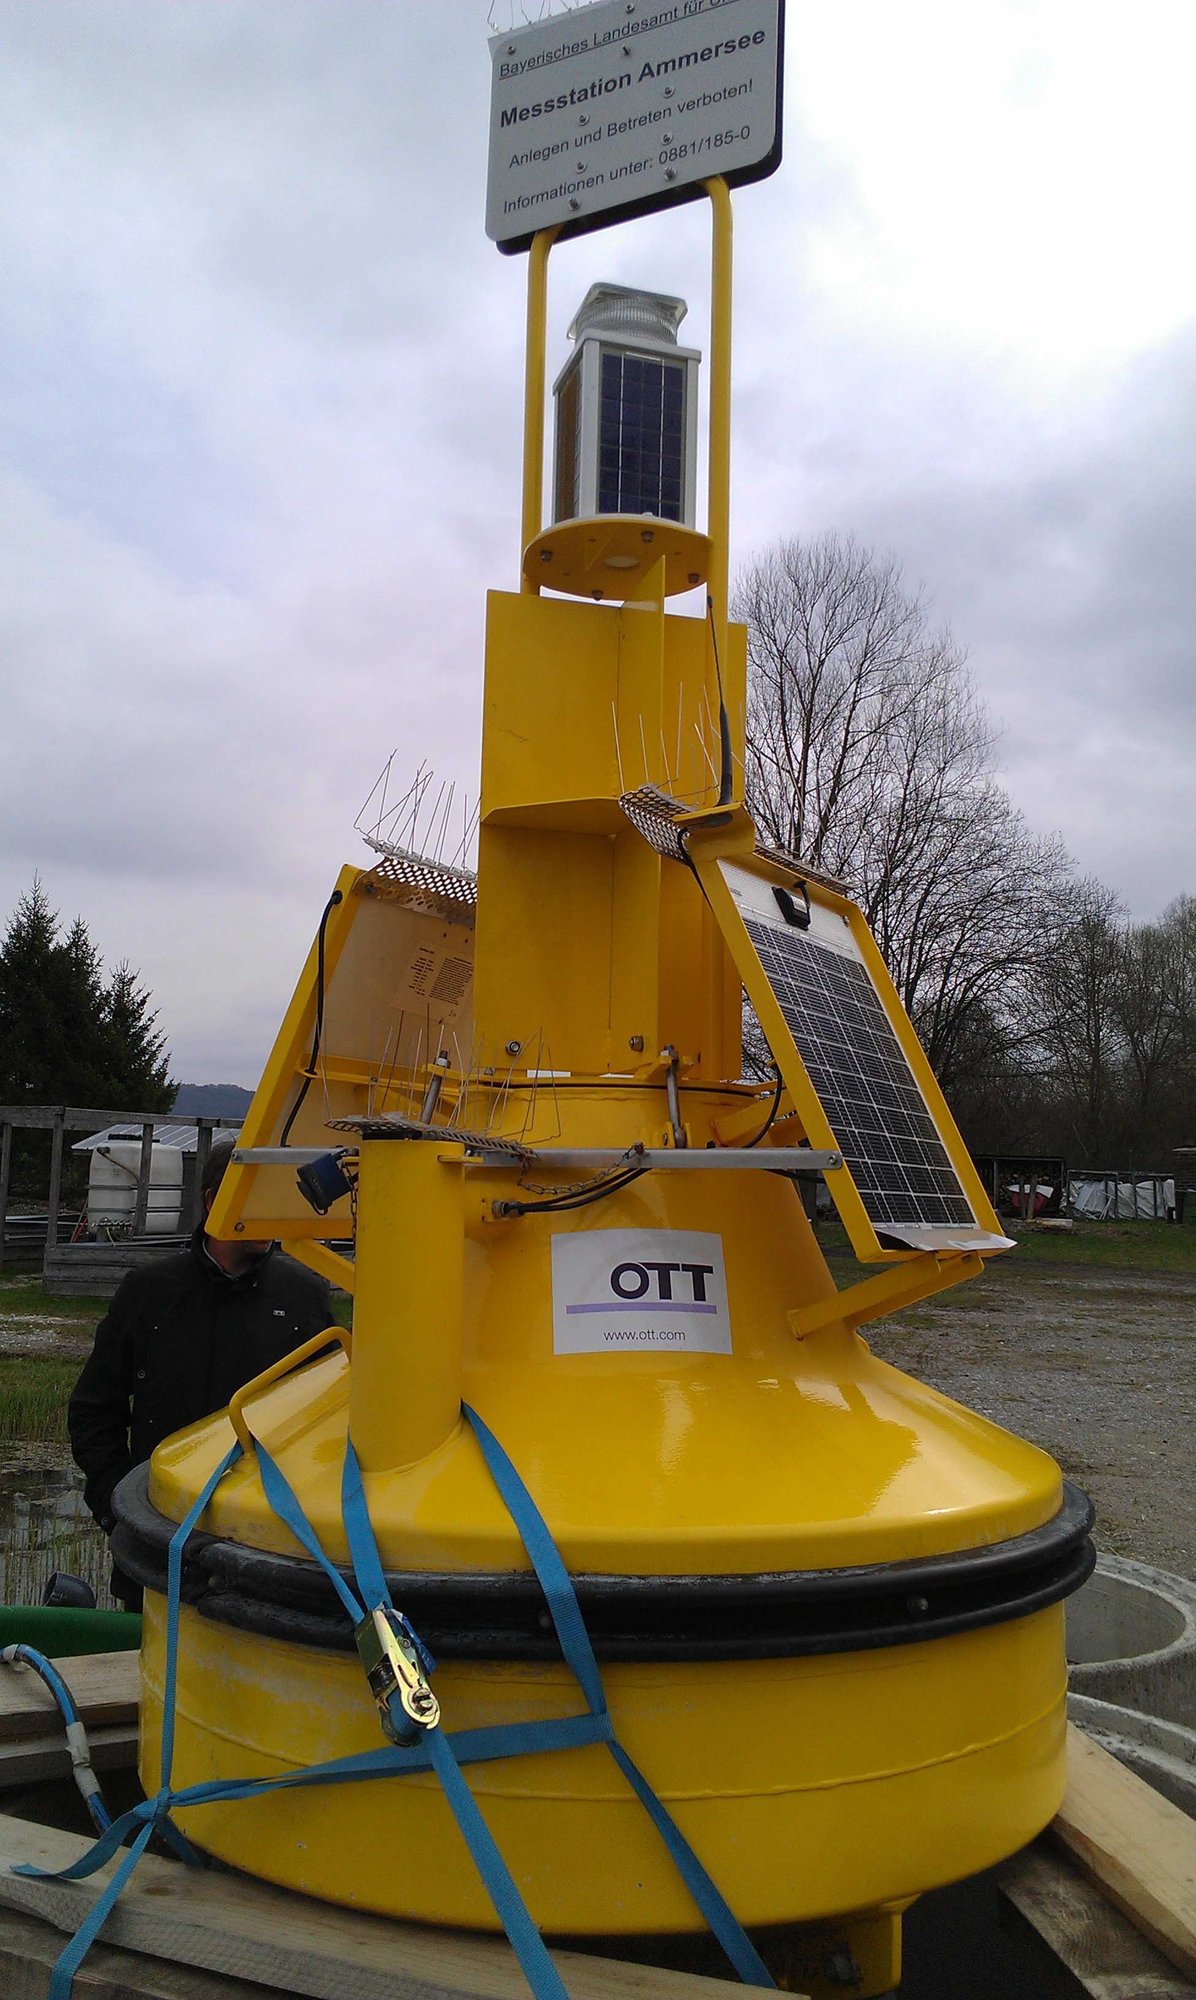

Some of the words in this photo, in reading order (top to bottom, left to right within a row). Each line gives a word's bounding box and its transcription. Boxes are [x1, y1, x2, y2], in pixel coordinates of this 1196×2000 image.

[499, 38, 589, 77] Bayerisches
[593, 7, 678, 45] Landesamt
[683, 0, 703, 15] für
[500, 71, 632, 127] Messstation
[638, 30, 766, 81] Ammersee
[509, 143, 569, 168] Anlegen
[574, 125, 602, 147] und
[607, 108, 672, 137] Betreten
[677, 78, 754, 113] verboten!
[503, 173, 605, 214] Informationen
[609, 157, 653, 180] unter:
[658, 125, 751, 164] 0881/185-0
[610, 1262, 714, 1302] OTT
[603, 1329, 686, 1341] www.ott.com
